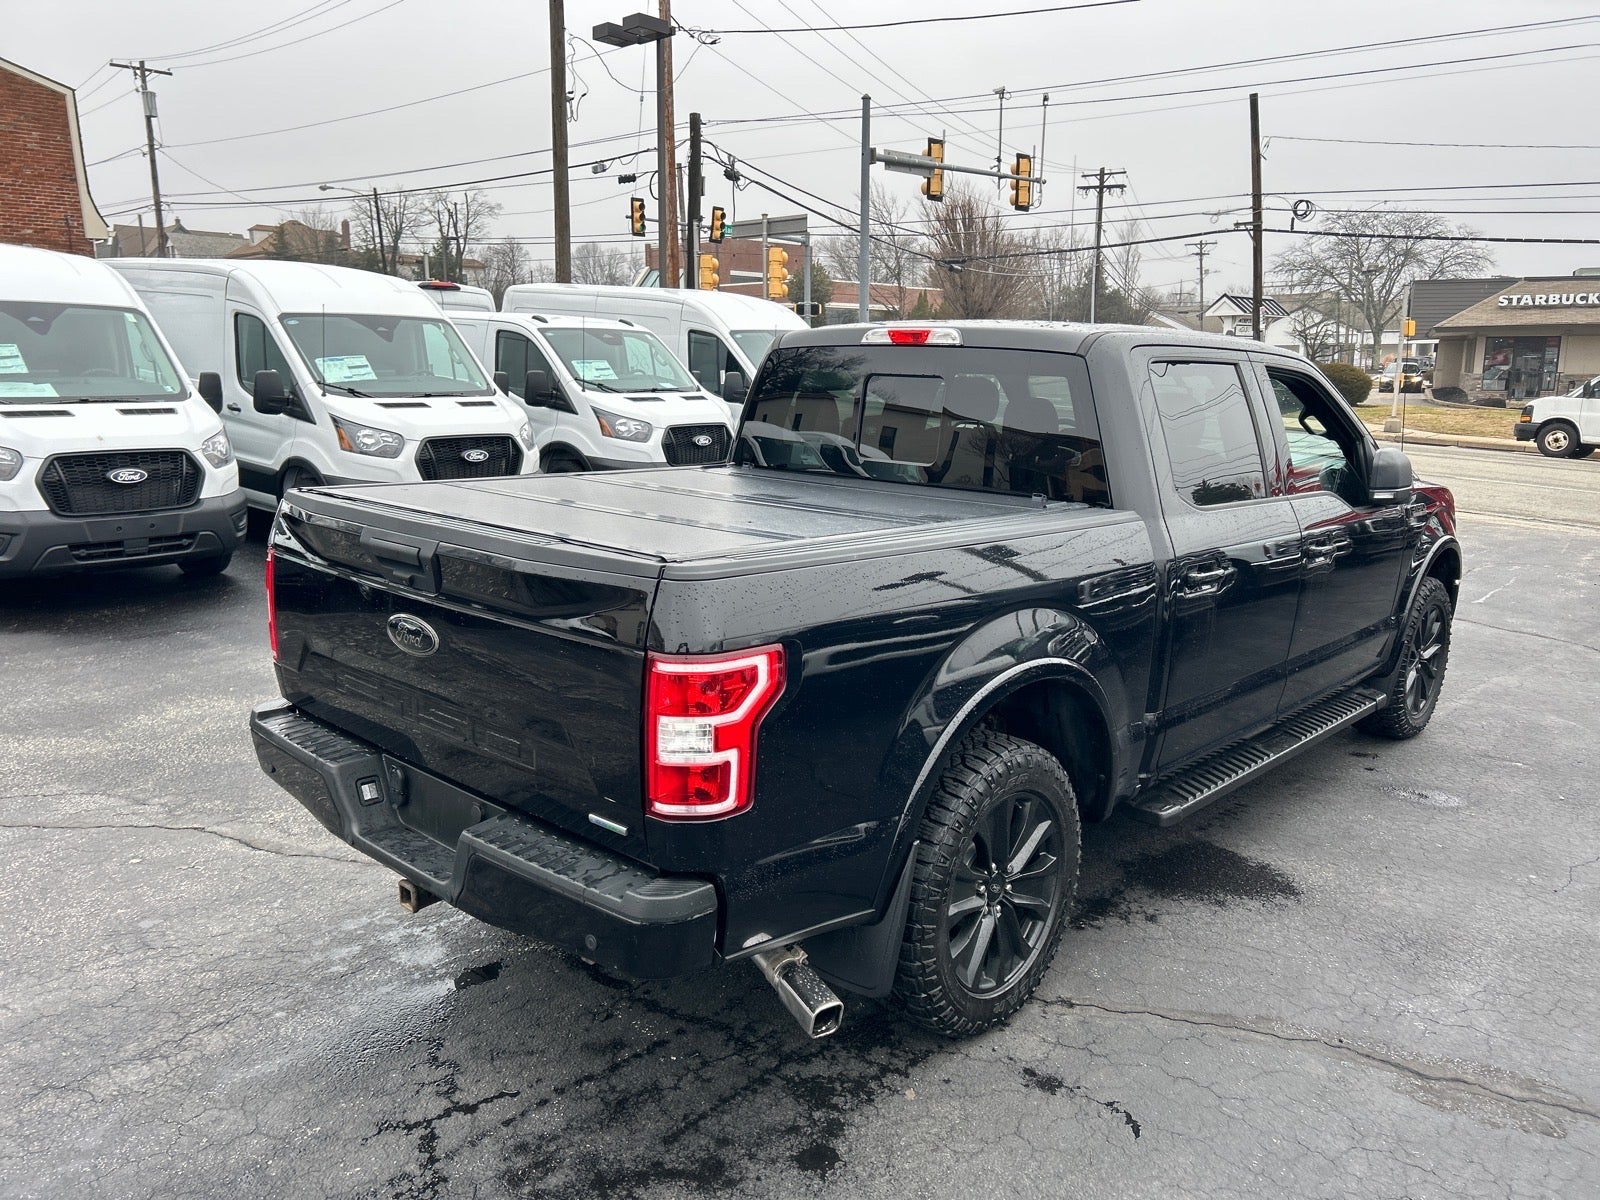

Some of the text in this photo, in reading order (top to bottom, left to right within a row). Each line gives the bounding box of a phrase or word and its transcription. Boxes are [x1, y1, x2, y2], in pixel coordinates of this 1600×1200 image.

[468, 451, 486, 461] Ford
[116, 470, 142, 481] Ford
[394, 620, 425, 649] Ford
